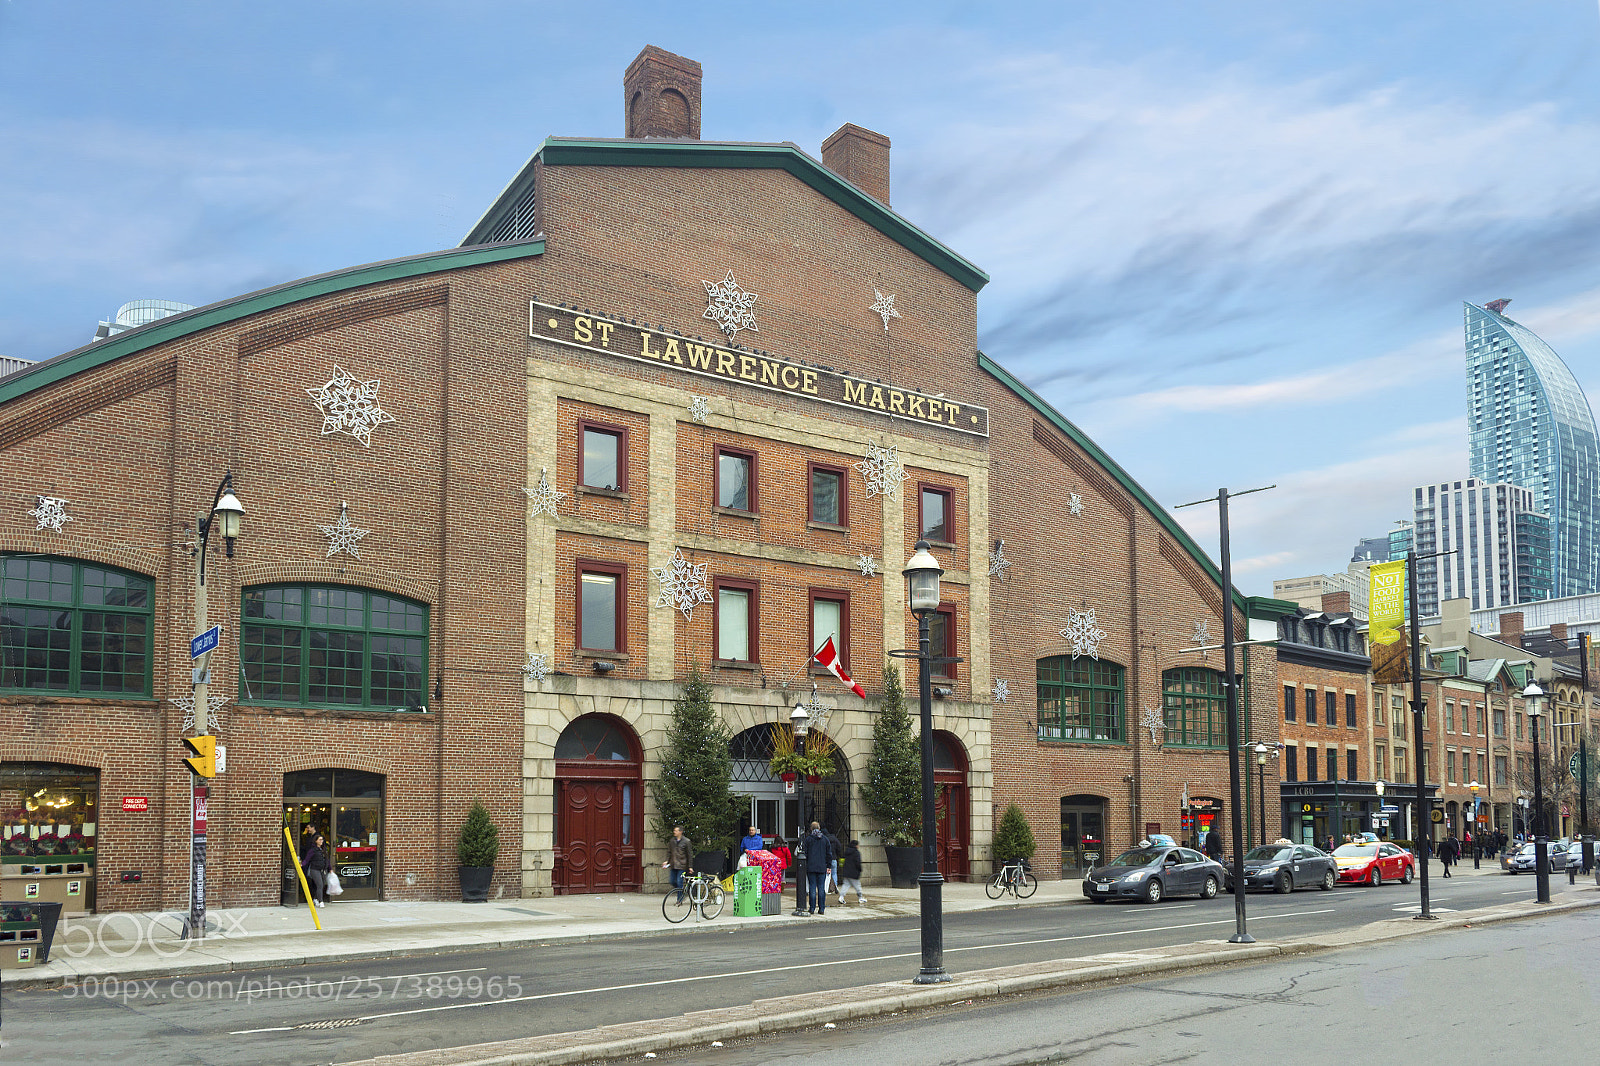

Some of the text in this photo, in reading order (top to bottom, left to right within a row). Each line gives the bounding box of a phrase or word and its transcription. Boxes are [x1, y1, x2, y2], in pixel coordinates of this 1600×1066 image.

[640, 331, 819, 395] LAWRENCE
[843, 380, 961, 426] MARKET
[1373, 586, 1401, 598] FOOD
[1373, 595, 1400, 603] MARKET
[1373, 601, 1400, 611] IN THE
[1373, 608, 1400, 617] WORLD
